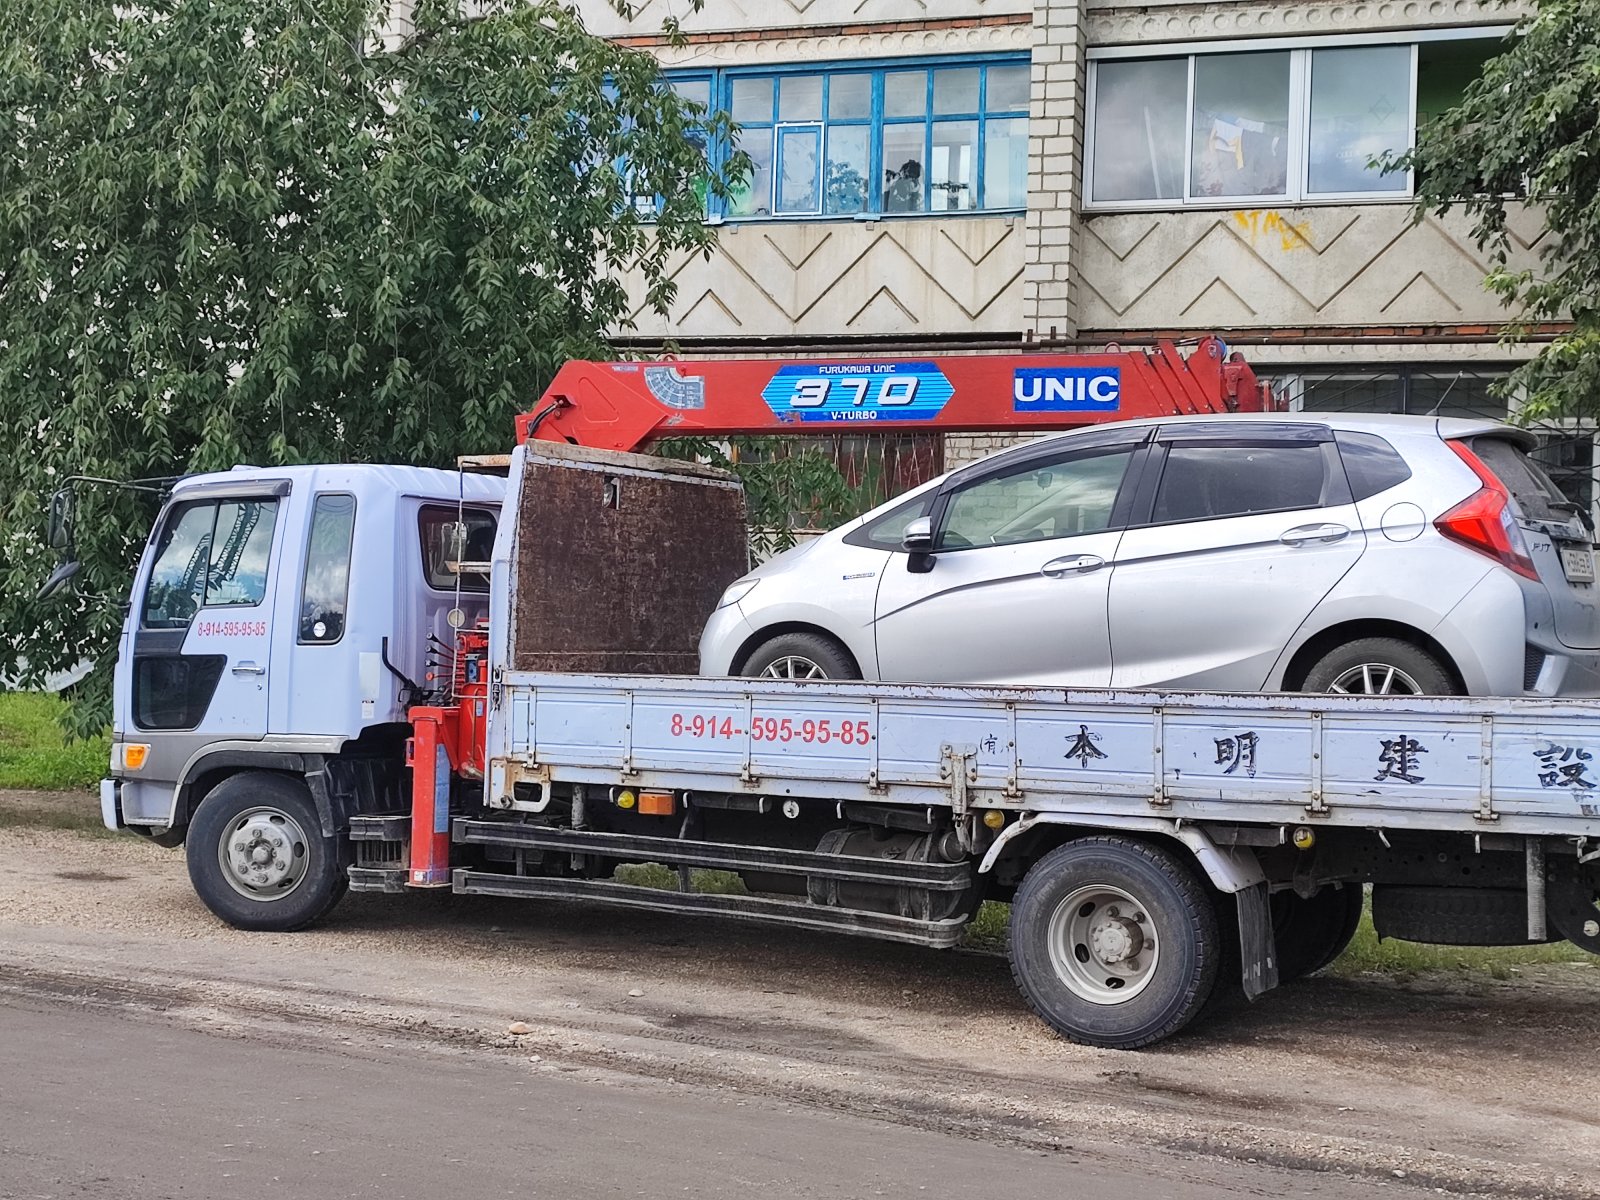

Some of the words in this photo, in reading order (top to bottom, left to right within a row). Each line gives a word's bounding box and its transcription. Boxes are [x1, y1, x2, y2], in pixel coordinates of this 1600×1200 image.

[819, 365, 871, 374] FURUKAWA
[789, 376, 920, 407] 370
[1014, 375, 1119, 402] UNIC
[831, 410, 877, 420] V-TURBO
[197, 621, 266, 637] 8-914-595-95-85
